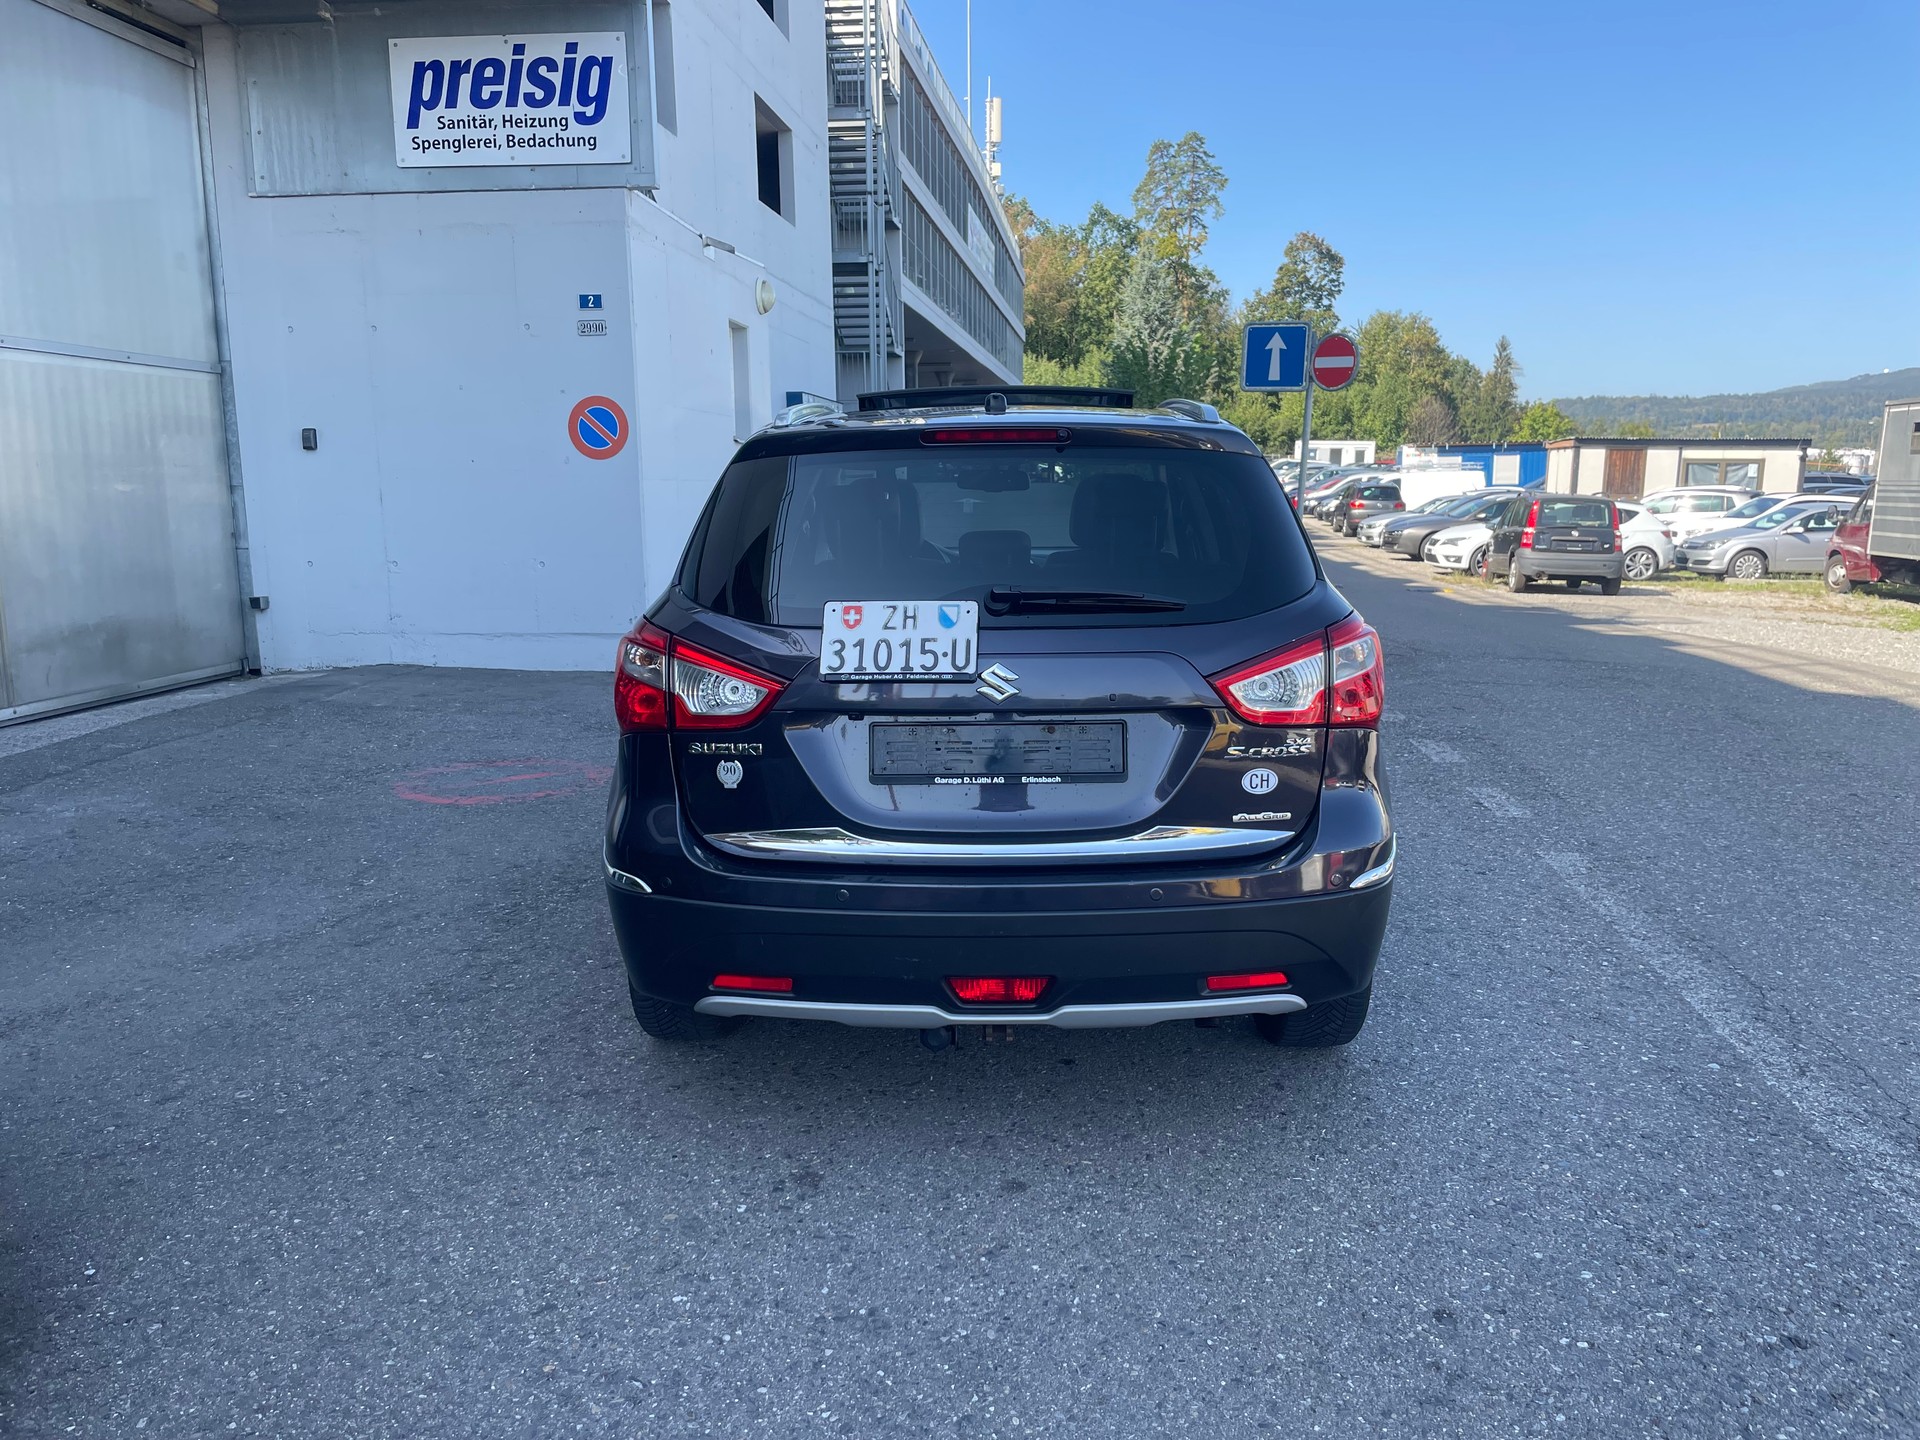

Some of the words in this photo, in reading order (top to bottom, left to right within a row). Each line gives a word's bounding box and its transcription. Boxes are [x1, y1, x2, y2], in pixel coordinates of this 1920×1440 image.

[406, 41, 614, 130] preisig
[436, 114, 498, 131] Sanitär,
[501, 114, 569, 132] Heizung
[411, 133, 502, 154] Spenglerei,
[505, 132, 598, 151] Bedachung
[588, 295, 594, 307] 2
[580, 322, 604, 334] 2990
[881, 604, 918, 631] ZH
[1284, 737, 1312, 745] SX4
[688, 742, 763, 756] SUZUKI
[722, 765, 737, 776] 90
[934, 776, 963, 785] Garage
[992, 776, 1005, 784] AG
[1021, 776, 1062, 784] Erlinsbach
[1249, 773, 1270, 790] CH
